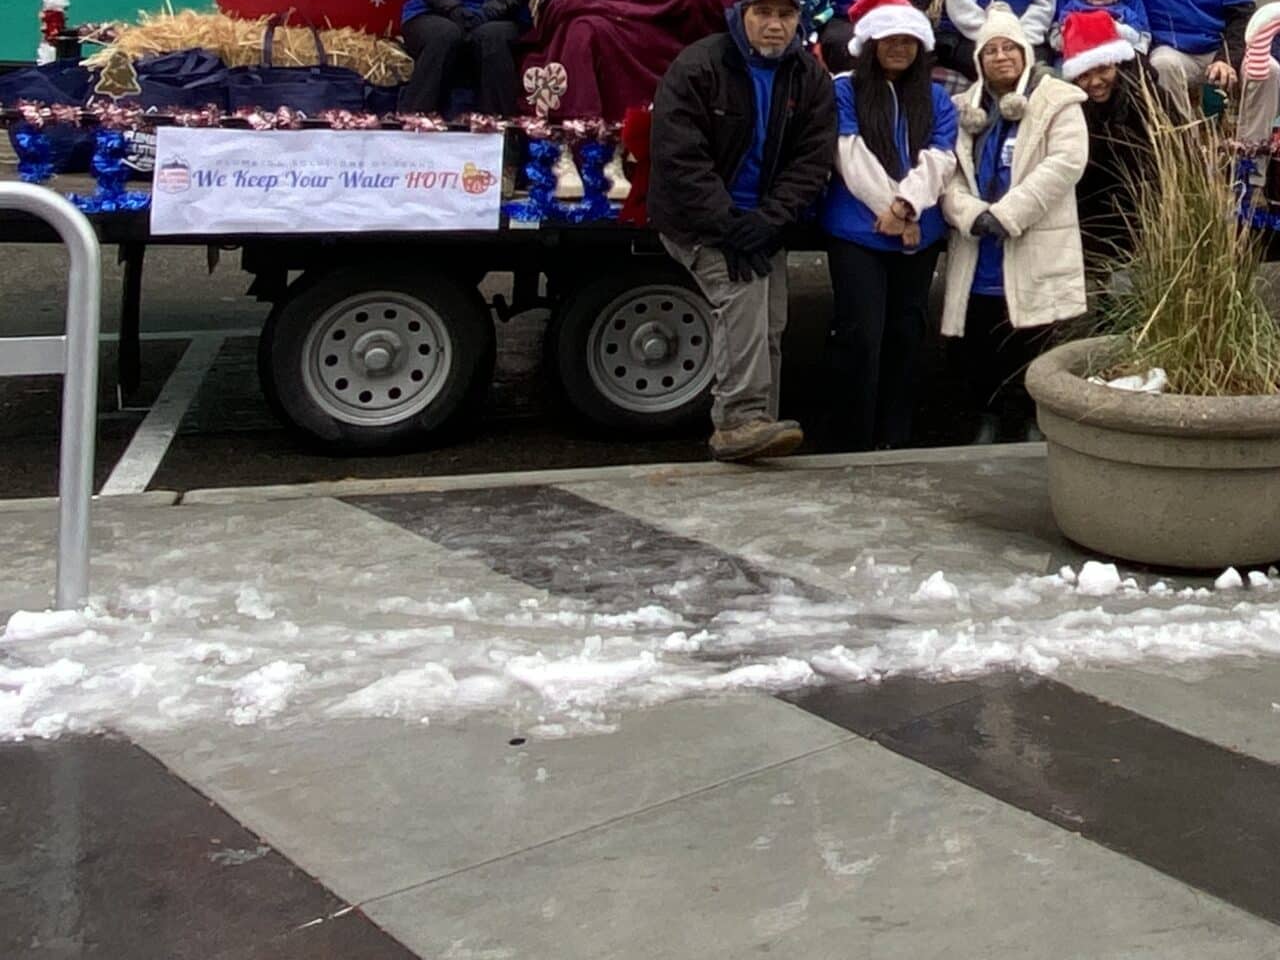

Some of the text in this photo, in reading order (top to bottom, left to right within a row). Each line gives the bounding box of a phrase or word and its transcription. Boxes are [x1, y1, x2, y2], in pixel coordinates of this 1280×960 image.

[192, 169, 228, 188] We
[233, 169, 279, 193] Keep
[285, 170, 334, 188] Your
[339, 170, 399, 189] Water
[404, 171, 460, 190] HOT!
